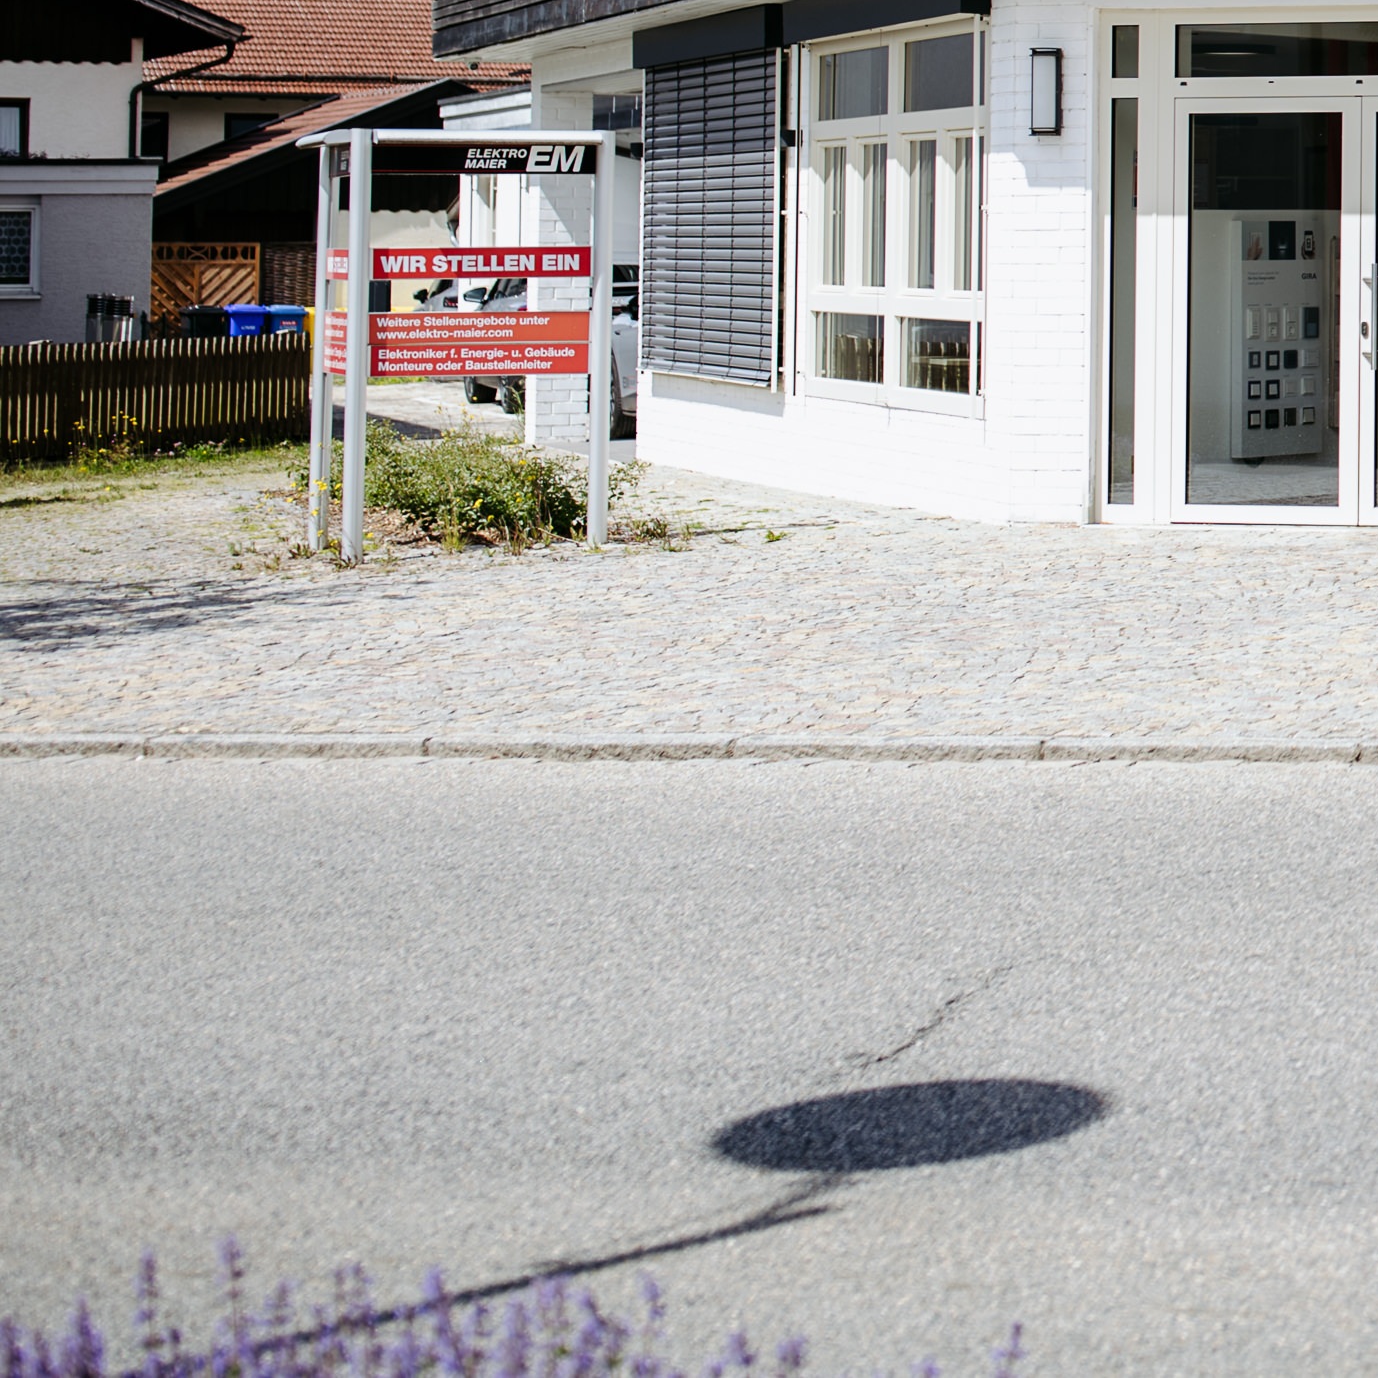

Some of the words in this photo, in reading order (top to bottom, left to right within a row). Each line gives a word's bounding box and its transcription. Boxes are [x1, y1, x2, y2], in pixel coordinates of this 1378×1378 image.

[467, 148, 527, 159] ELEKTRO
[525, 145, 585, 172] EM
[464, 158, 507, 169] MAIER
[380, 256, 426, 273] WIR
[432, 254, 535, 272] STELLEN
[542, 254, 580, 271] EIN
[376, 317, 421, 328] Weitere
[423, 316, 517, 328] Stellenangebote
[519, 316, 550, 326] unter
[376, 328, 513, 340] www.elektro-maier.com
[378, 348, 447, 360] Elektroniker
[450, 348, 458, 358] f.
[460, 347, 509, 360] Energie-
[511, 349, 522, 358] u.
[524, 347, 576, 358] Gebäude
[378, 361, 434, 371] Monteure
[435, 360, 462, 371] oder
[465, 360, 552, 371] Baustellenleiter
